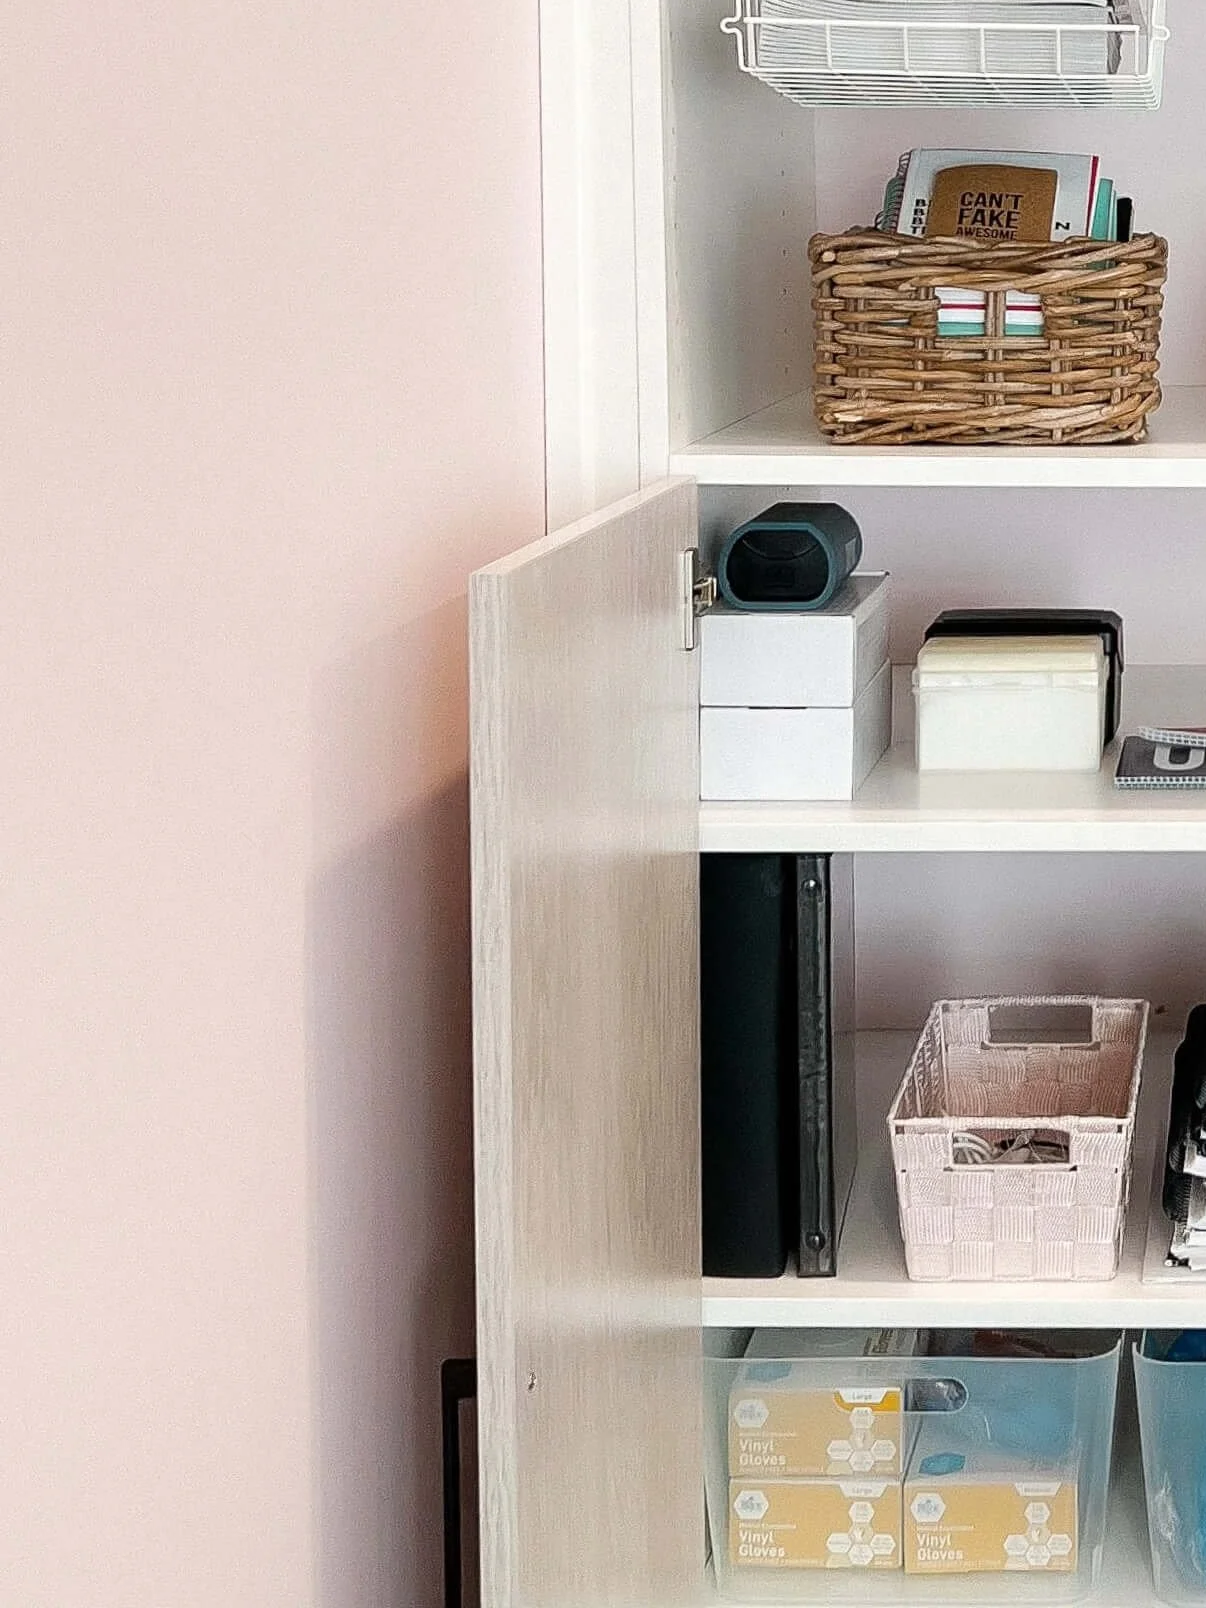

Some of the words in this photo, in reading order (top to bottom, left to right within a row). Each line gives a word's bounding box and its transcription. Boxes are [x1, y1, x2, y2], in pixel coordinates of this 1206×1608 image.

[960, 191, 1024, 209] CAN'T
[957, 208, 1019, 229] FAKE
[955, 226, 1017, 240] AWESOME
[739, 1439, 774, 1454] Vinyl
[739, 1454, 786, 1466] Gloves
[739, 1530, 774, 1544] Vinyl
[917, 1533, 952, 1547] Vinyl
[738, 1544, 786, 1557] Gloves
[917, 1547, 964, 1561] Gloves
